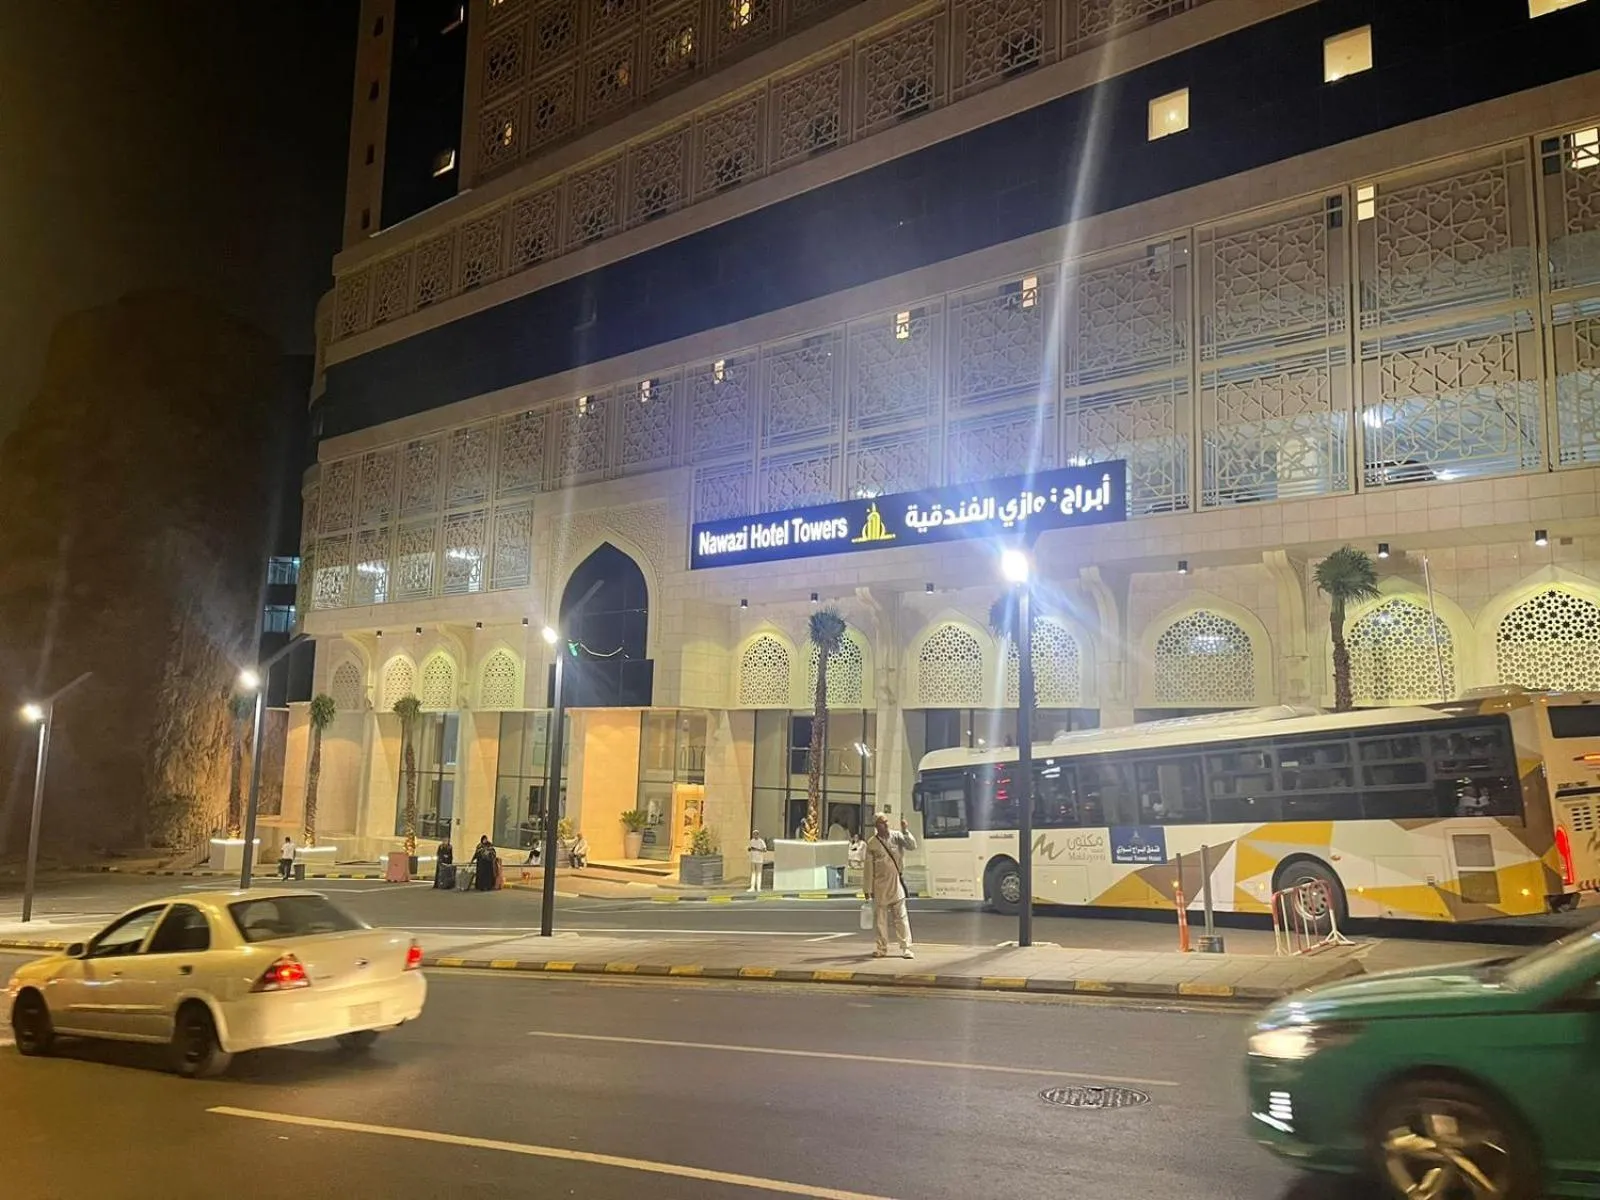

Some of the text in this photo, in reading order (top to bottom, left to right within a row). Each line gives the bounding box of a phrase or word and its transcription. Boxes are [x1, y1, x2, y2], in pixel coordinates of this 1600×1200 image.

[1059, 473, 1110, 515] أبراج
[905, 496, 995, 533] الفندقية
[699, 517, 849, 556] Nawazi Hotel Towers
